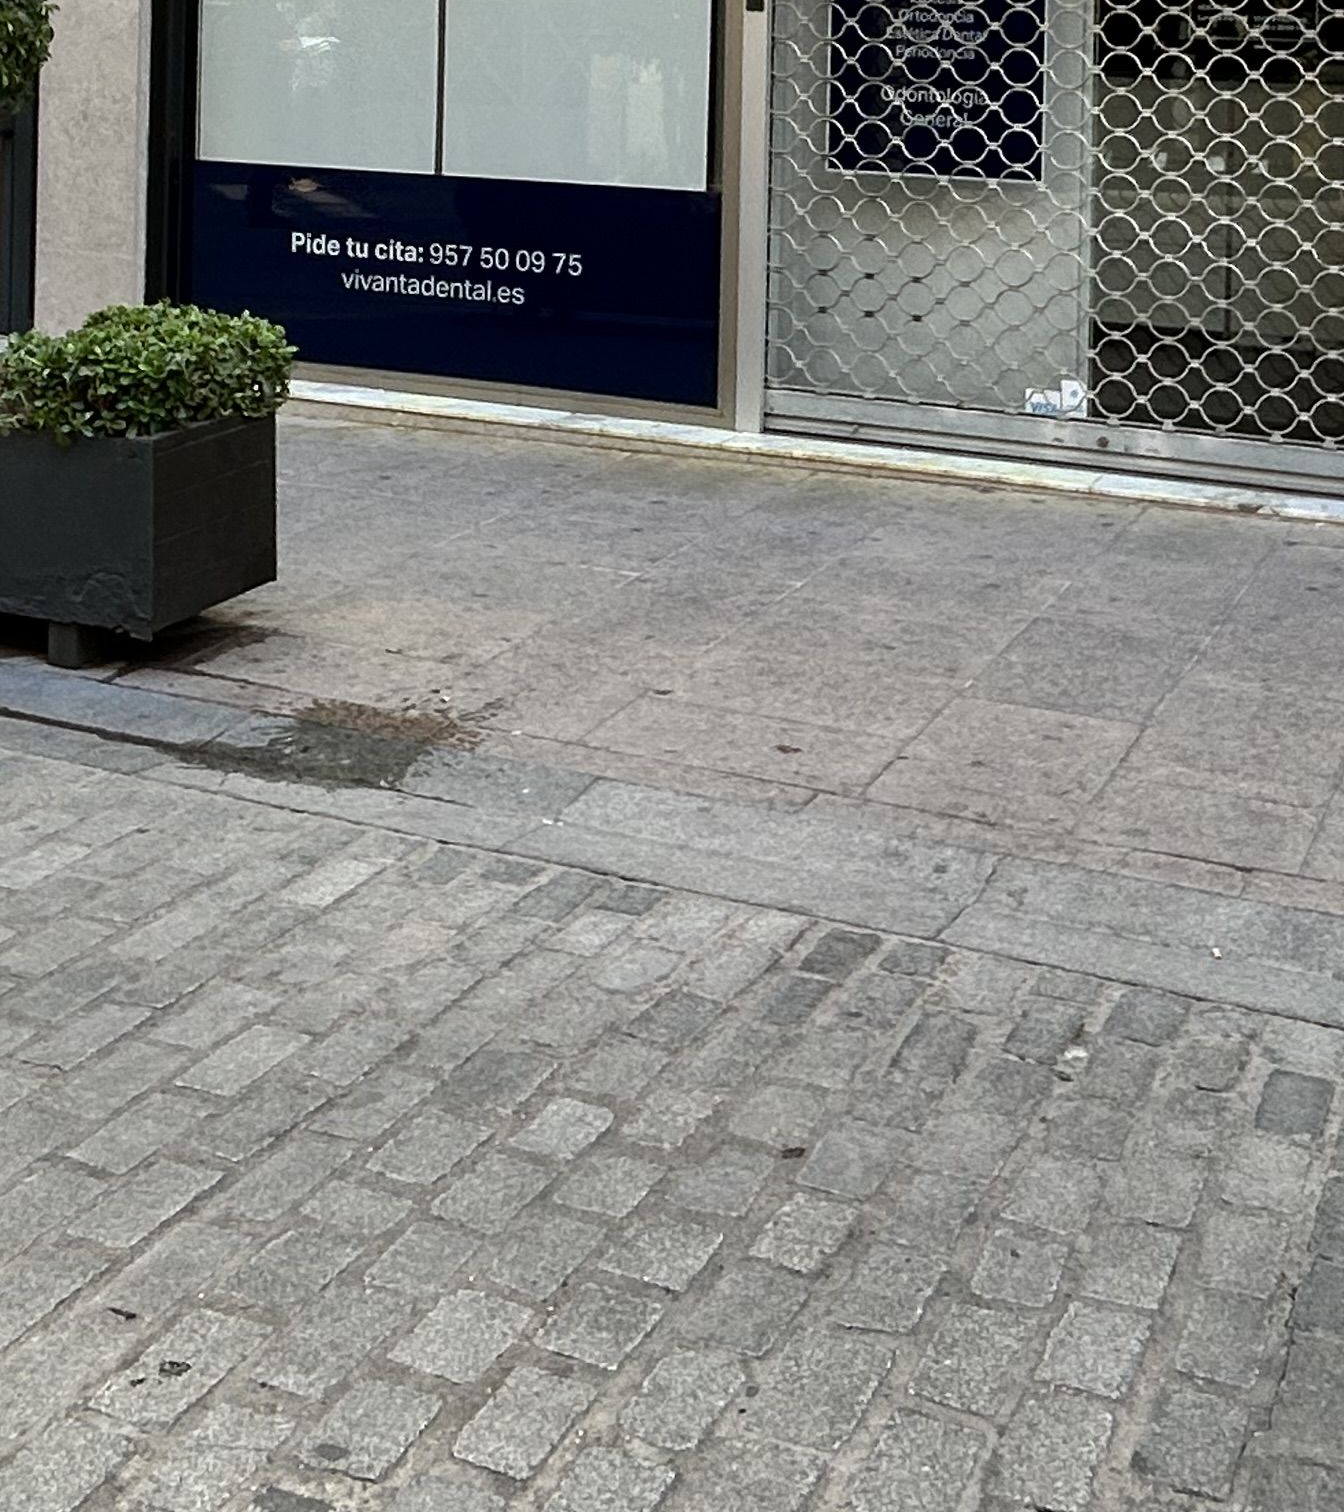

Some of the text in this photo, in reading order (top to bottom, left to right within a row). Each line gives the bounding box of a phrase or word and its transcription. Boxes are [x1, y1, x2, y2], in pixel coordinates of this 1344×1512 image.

[291, 231, 583, 277] Pide tu cita: 957 50 09 75
[341, 269, 526, 305] vivantadental.es
